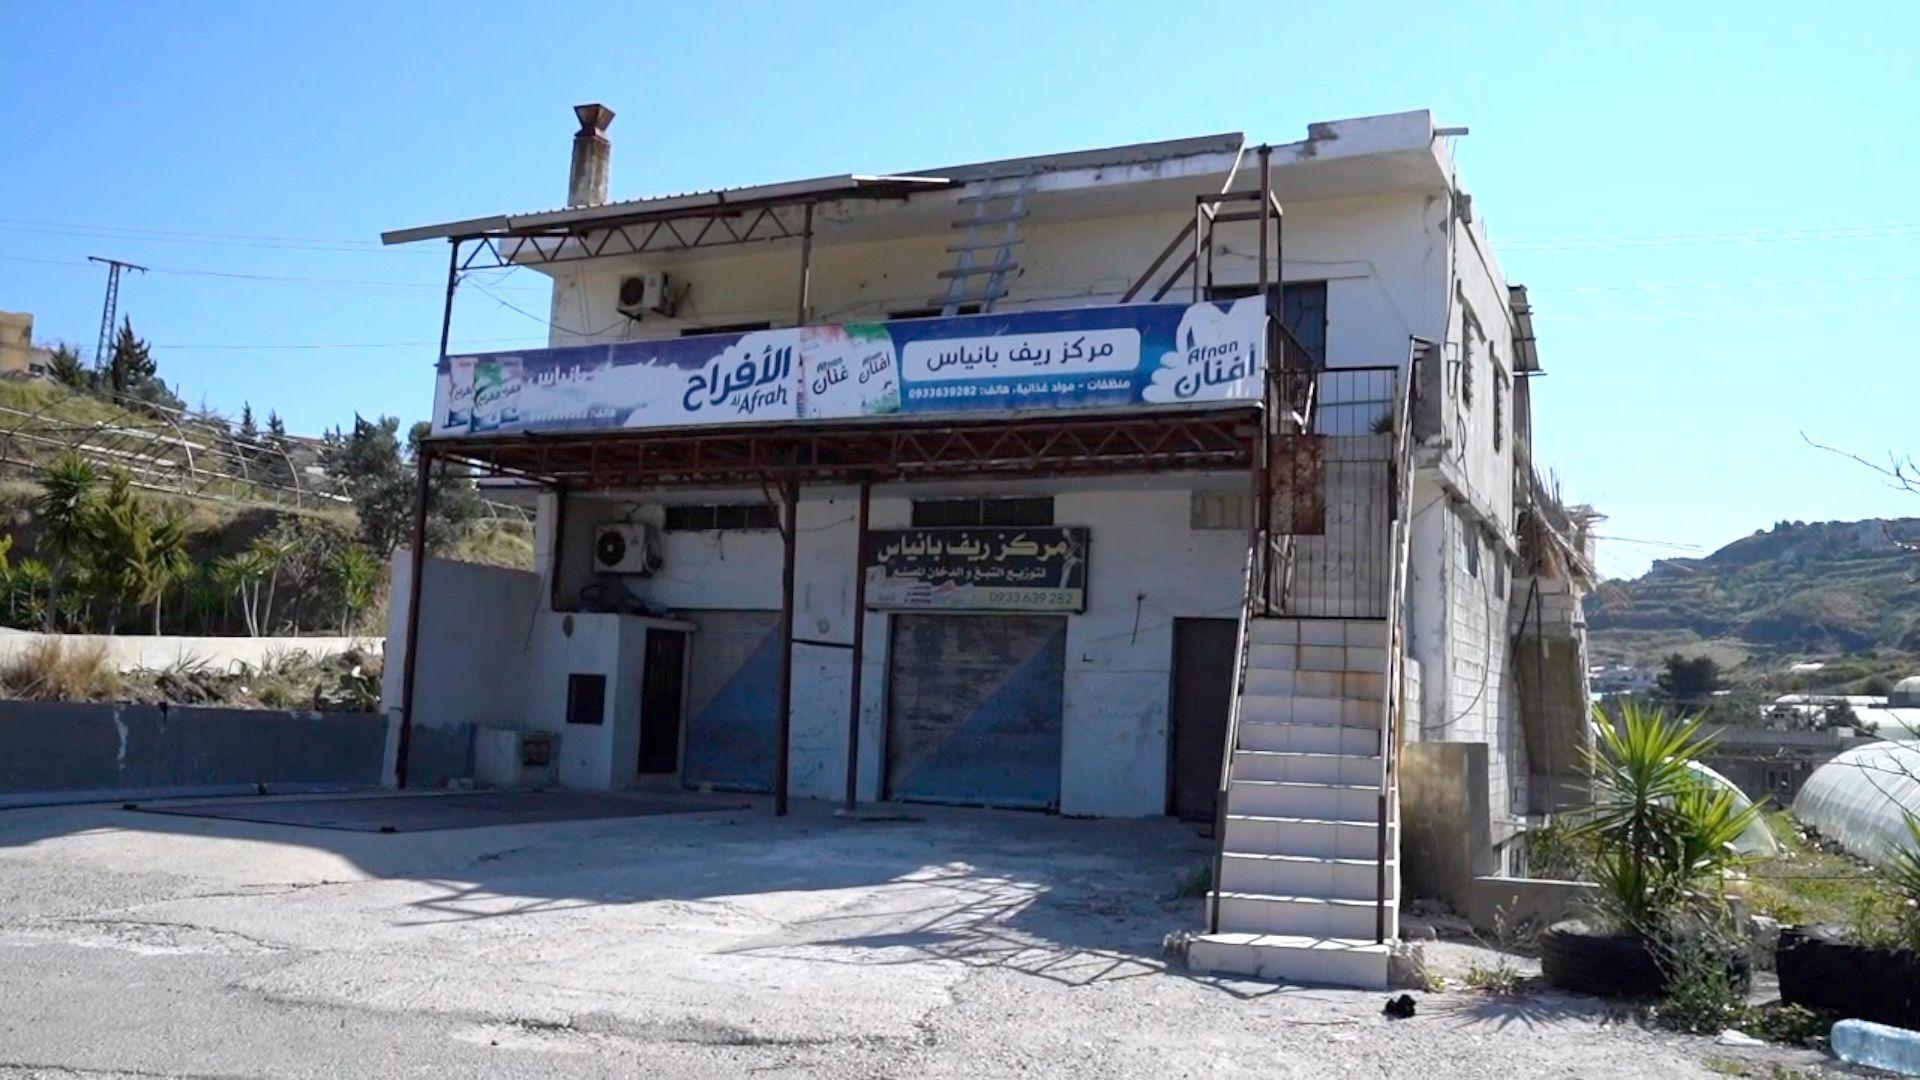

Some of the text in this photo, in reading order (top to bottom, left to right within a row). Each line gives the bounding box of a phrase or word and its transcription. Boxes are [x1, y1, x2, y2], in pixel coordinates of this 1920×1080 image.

[927, 336, 1114, 372] مركز ريف بانياس
[1188, 340, 1239, 366] Afnan
[683, 344, 793, 411] الأفراح
[1051, 382, 1075, 393] مواد
[737, 384, 787, 414] Afrah
[877, 532, 1068, 562] مركز ريف بانياس
